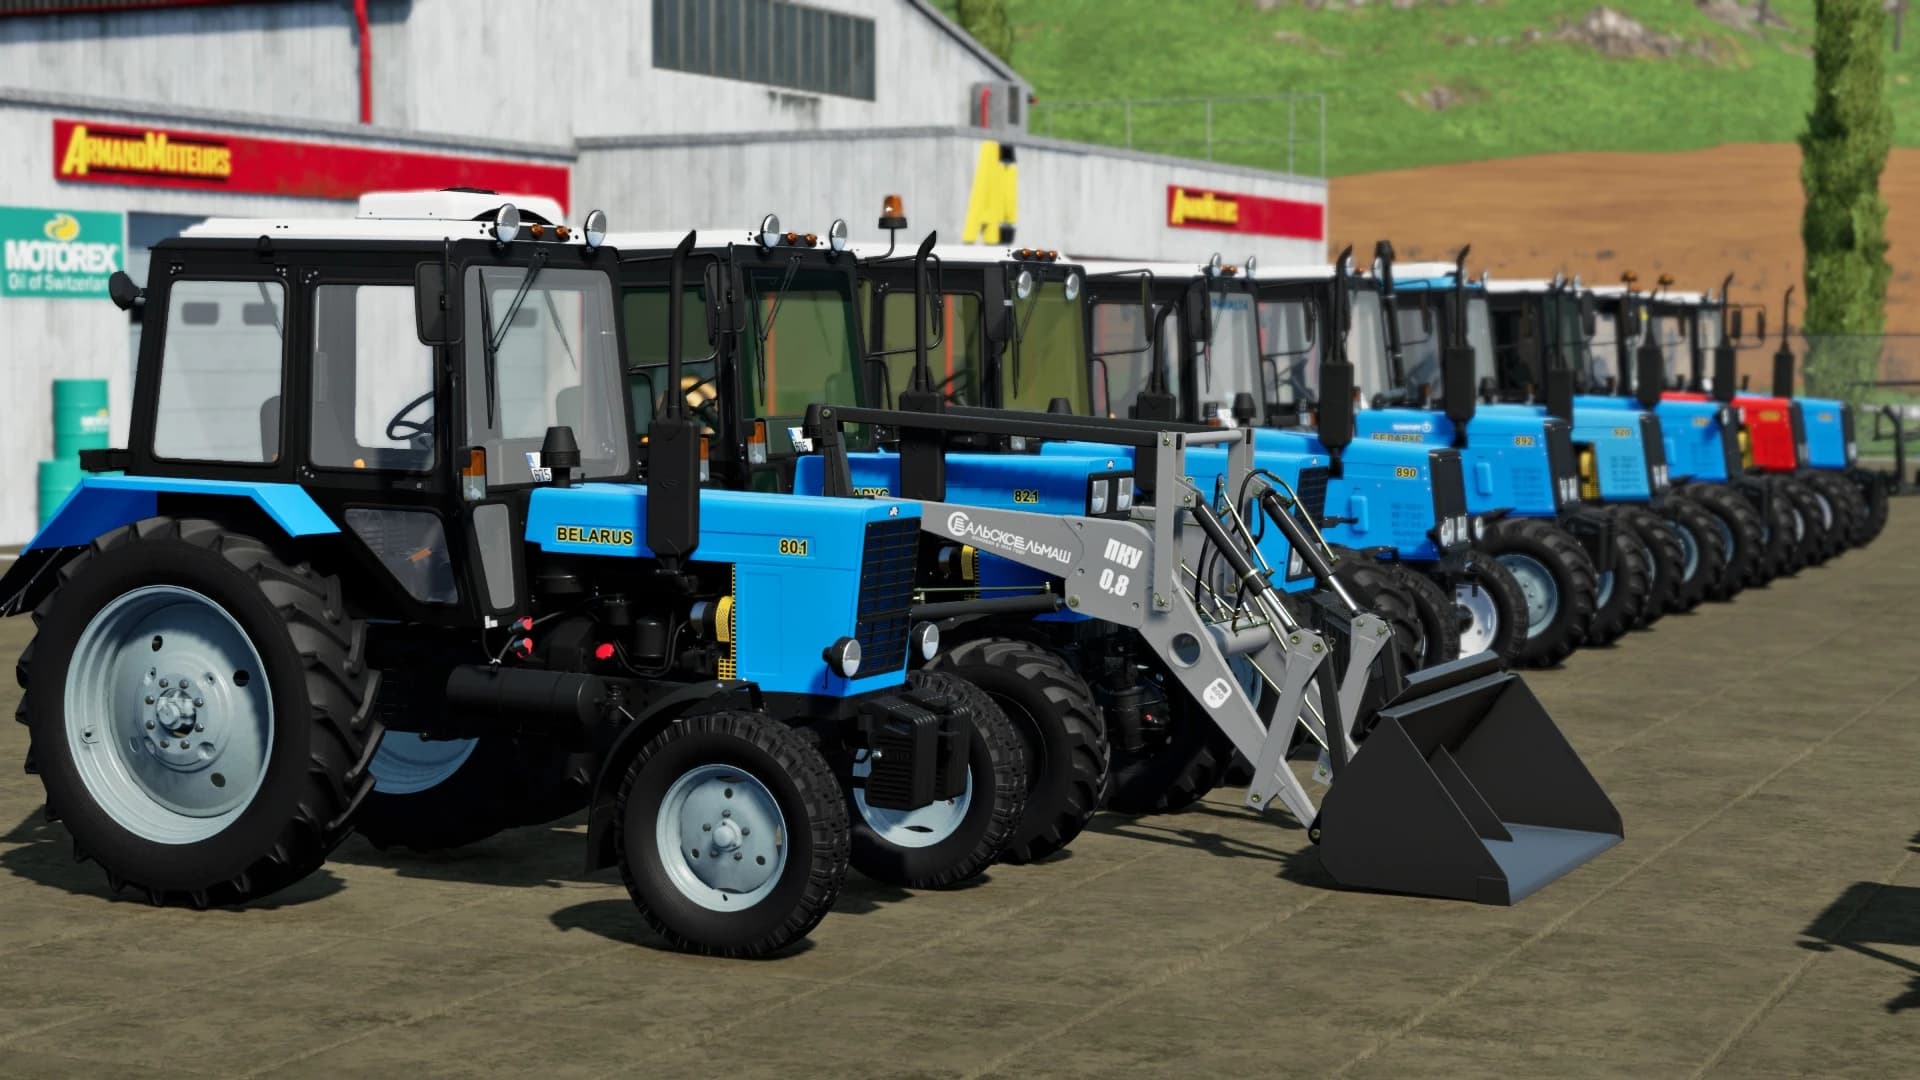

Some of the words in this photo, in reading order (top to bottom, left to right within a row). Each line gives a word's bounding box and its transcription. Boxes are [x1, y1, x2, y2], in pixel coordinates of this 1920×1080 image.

[6, 239, 118, 273] MOTOREX
[1395, 466, 1417, 480] 890
[556, 526, 634, 546] BELARUS
[1104, 538, 1143, 569] ПКУ
[1099, 568, 1130, 596] 0,8
